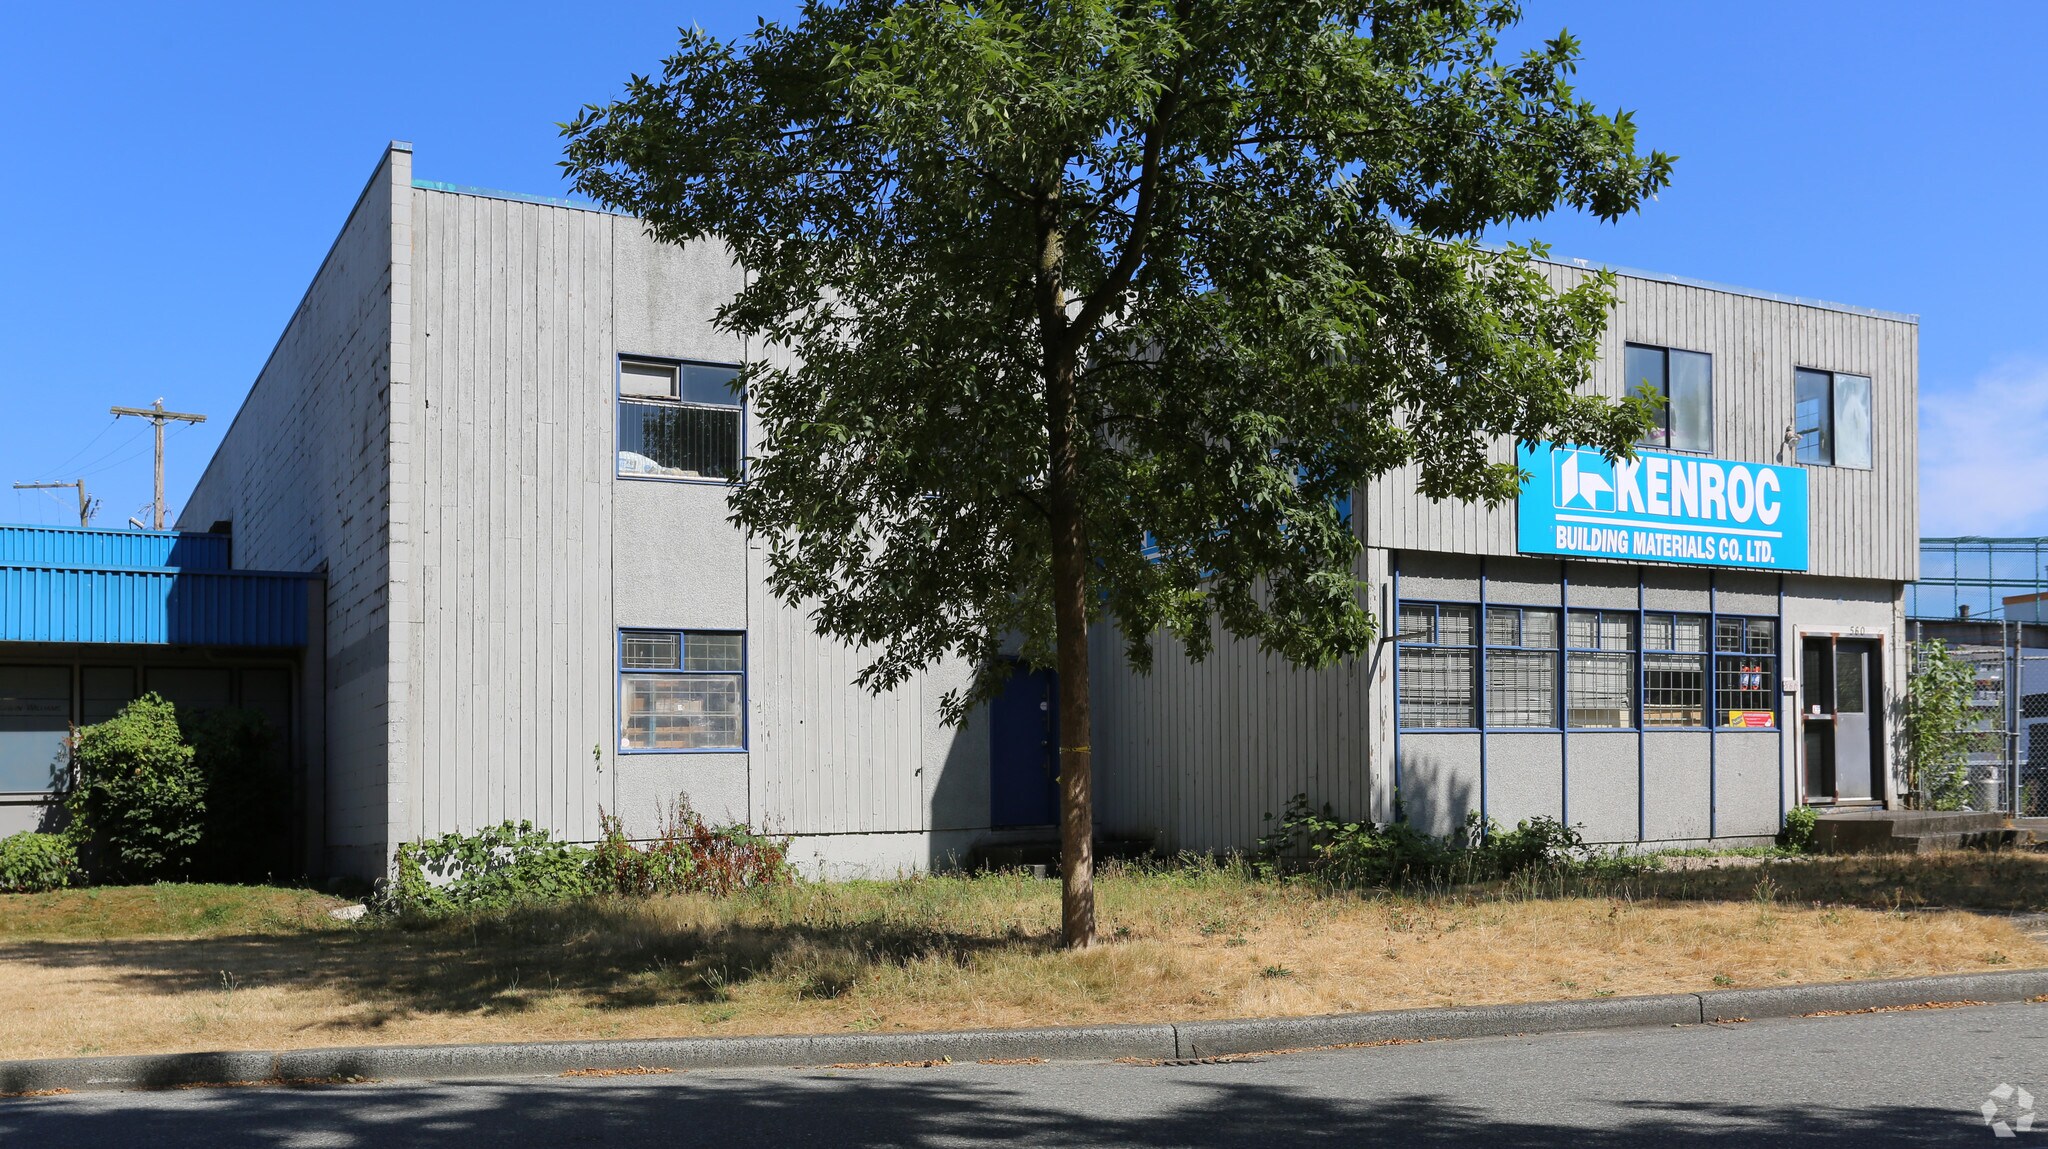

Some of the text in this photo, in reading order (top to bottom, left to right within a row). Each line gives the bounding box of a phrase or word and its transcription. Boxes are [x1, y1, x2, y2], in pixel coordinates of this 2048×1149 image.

[1617, 455, 1781, 525] KENROC
[1556, 525, 1775, 563] BUILDING MATERIALS CO. LTD.
[1849, 626, 1866, 636] 560
